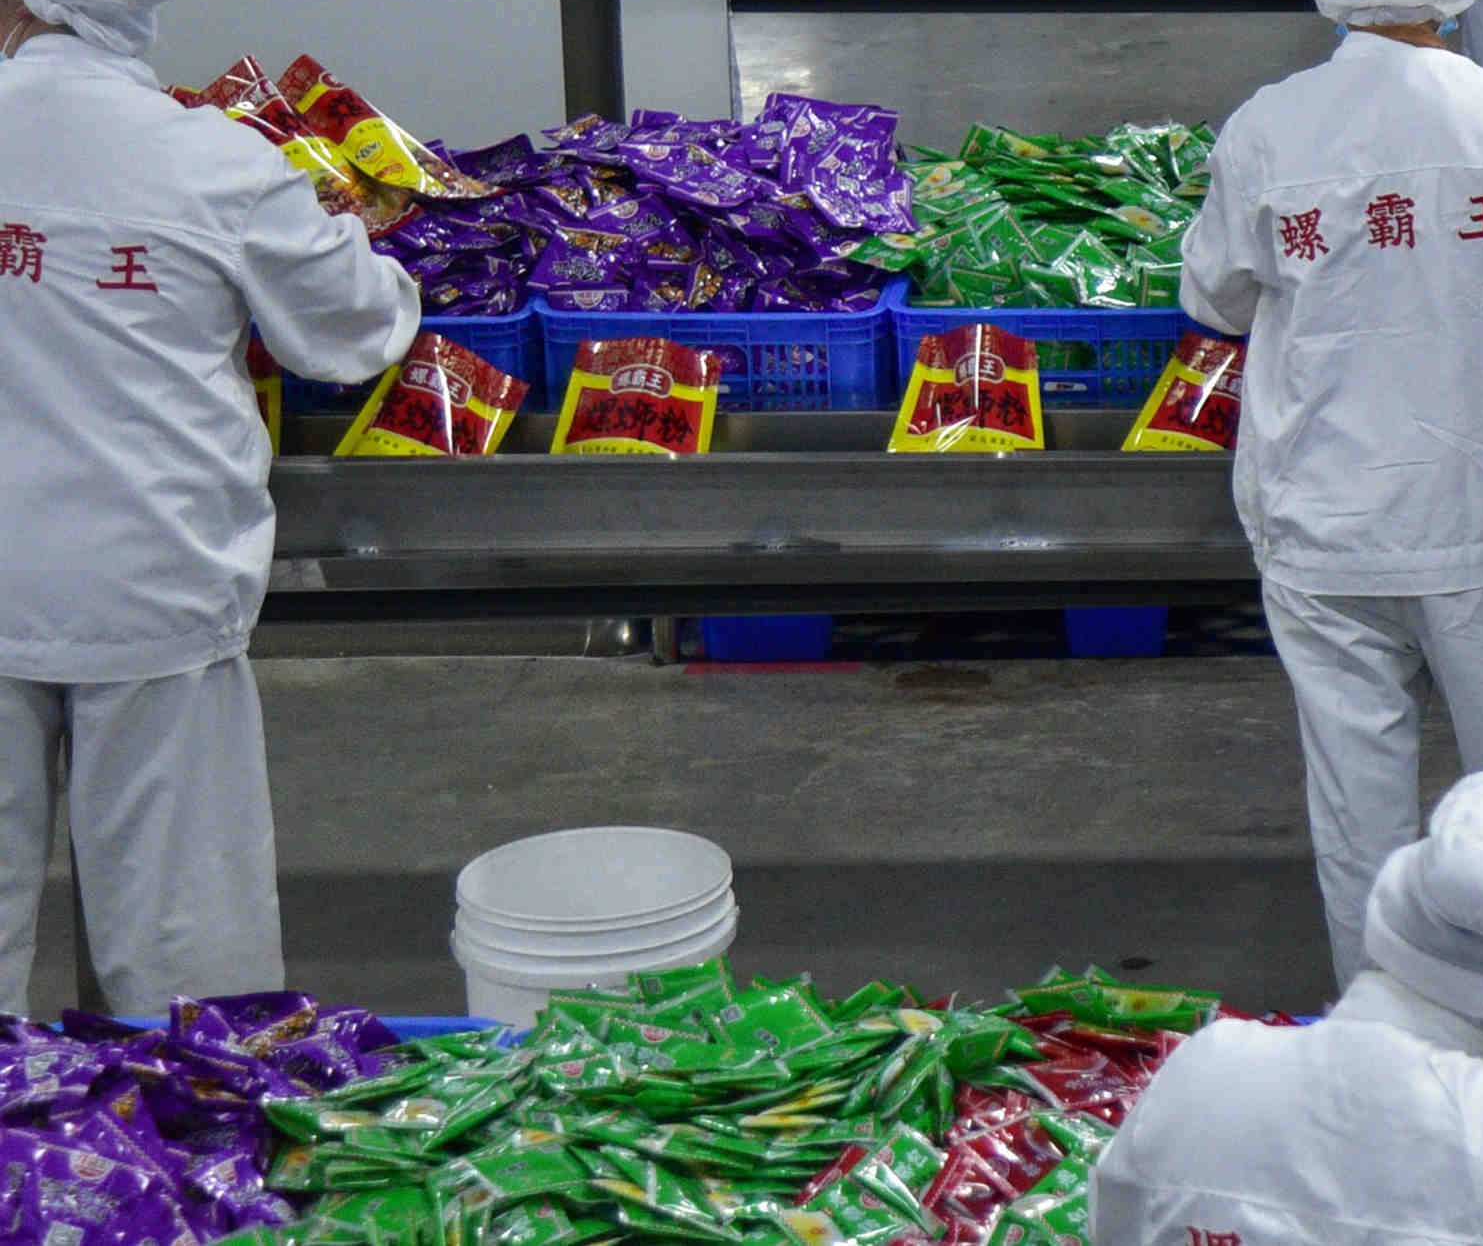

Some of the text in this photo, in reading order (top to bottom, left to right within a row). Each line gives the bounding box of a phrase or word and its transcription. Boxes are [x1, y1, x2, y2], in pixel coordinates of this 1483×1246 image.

[0, 223, 160, 295] 霸王
[617, 371, 663, 392] 螺霸王
